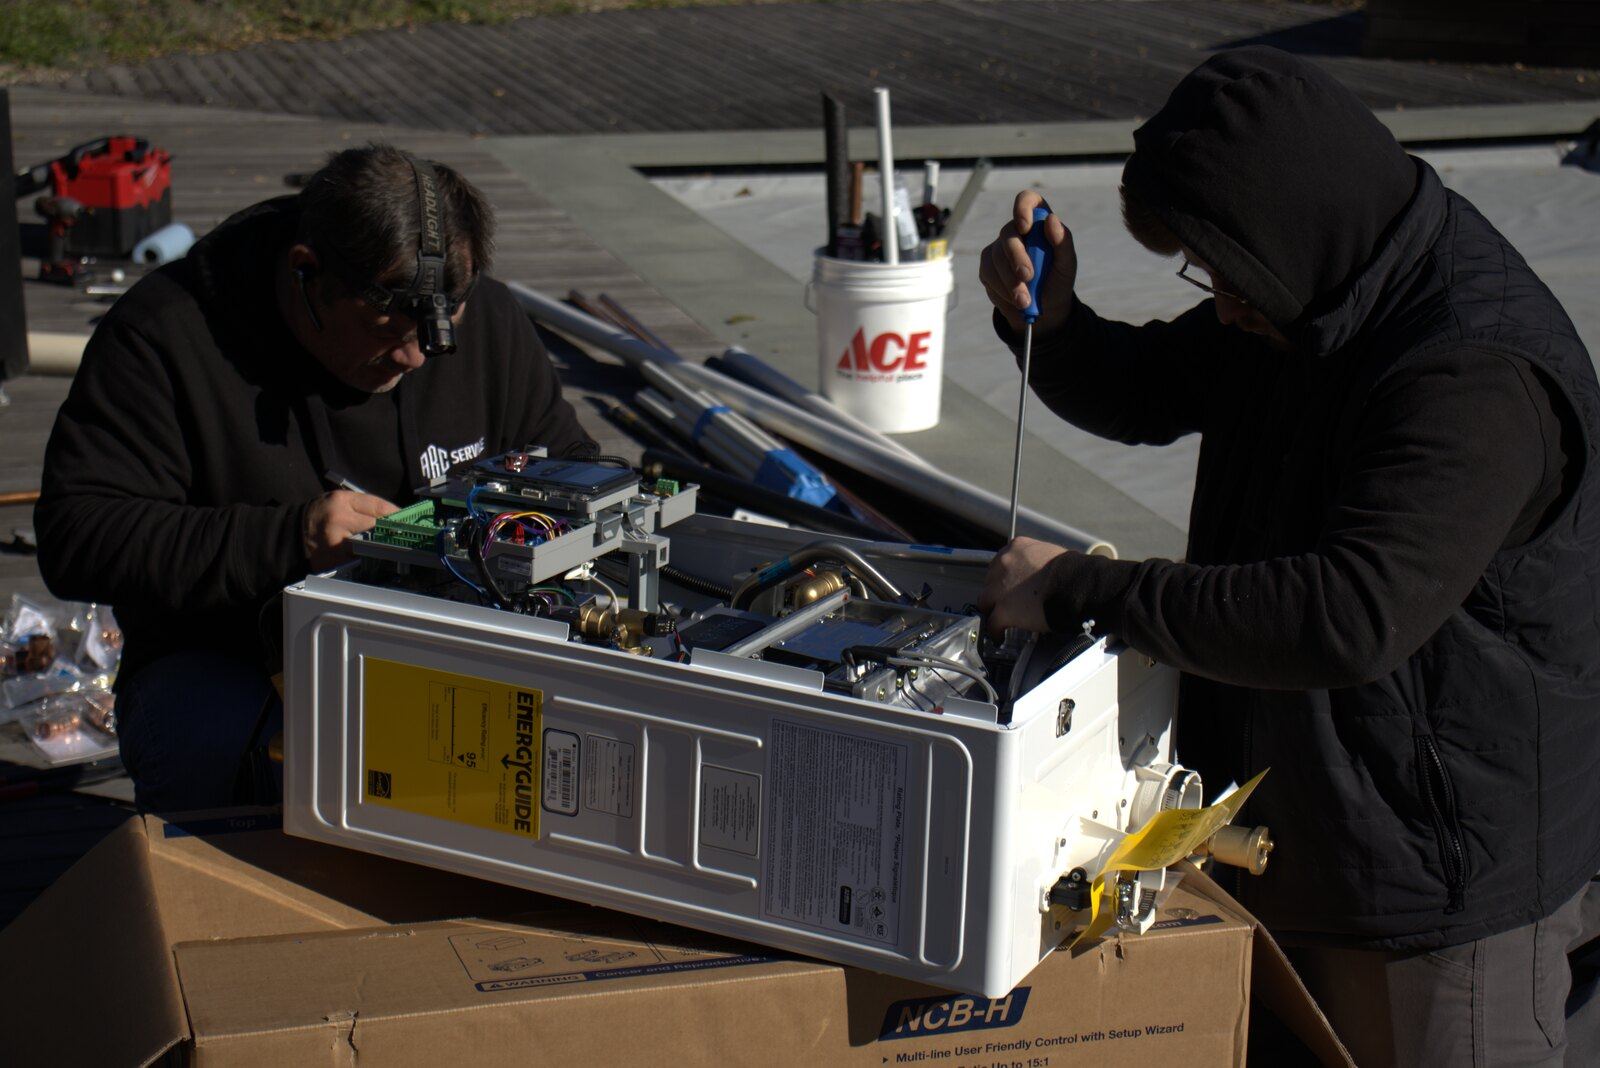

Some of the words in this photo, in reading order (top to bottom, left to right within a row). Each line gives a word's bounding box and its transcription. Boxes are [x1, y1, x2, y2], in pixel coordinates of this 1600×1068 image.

[422, 172, 441, 251] HEADLIGHT
[836, 325, 931, 373] ACE
[420, 444, 450, 479] ARC
[466, 752, 476, 768] 95
[514, 691, 534, 833] ENERGYGUIDE
[228, 818, 257, 830] Top
[505, 976, 579, 987] WARNING
[595, 969, 642, 978] Cancer
[895, 994, 1014, 1033] NCB-H
[896, 1050, 951, 1063] Multi-line
[955, 1046, 983, 1057] User
[985, 1039, 1032, 1053] Friendly
[1035, 1034, 1078, 1047] Control
[1081, 1031, 1105, 1042] with
[1108, 1028, 1142, 1039] Setup
[1145, 1023, 1185, 1035] Wizard
[1026, 1057, 1049, 1068] 15:1
